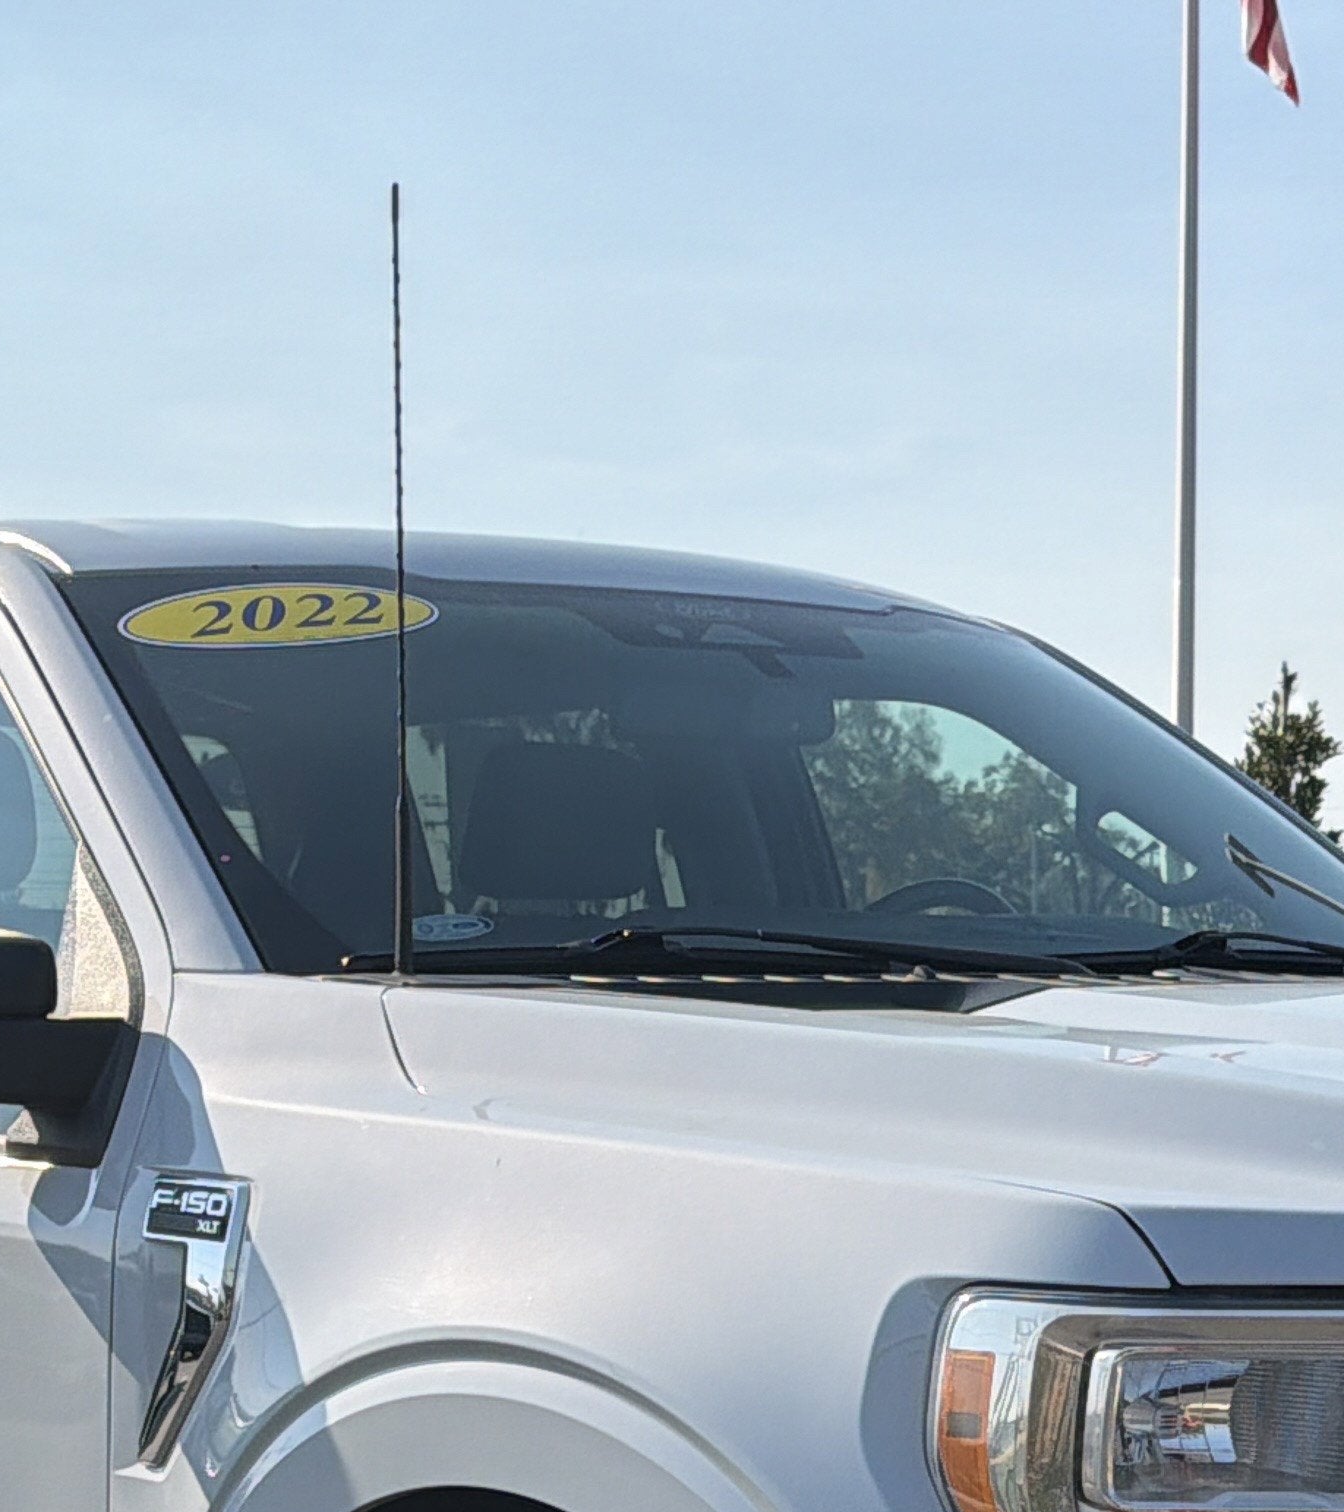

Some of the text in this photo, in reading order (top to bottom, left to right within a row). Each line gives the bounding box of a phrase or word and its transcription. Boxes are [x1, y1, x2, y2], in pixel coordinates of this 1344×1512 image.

[191, 592, 385, 638] 2022
[151, 1189, 228, 1217] F-150
[196, 1218, 222, 1234] XLT
